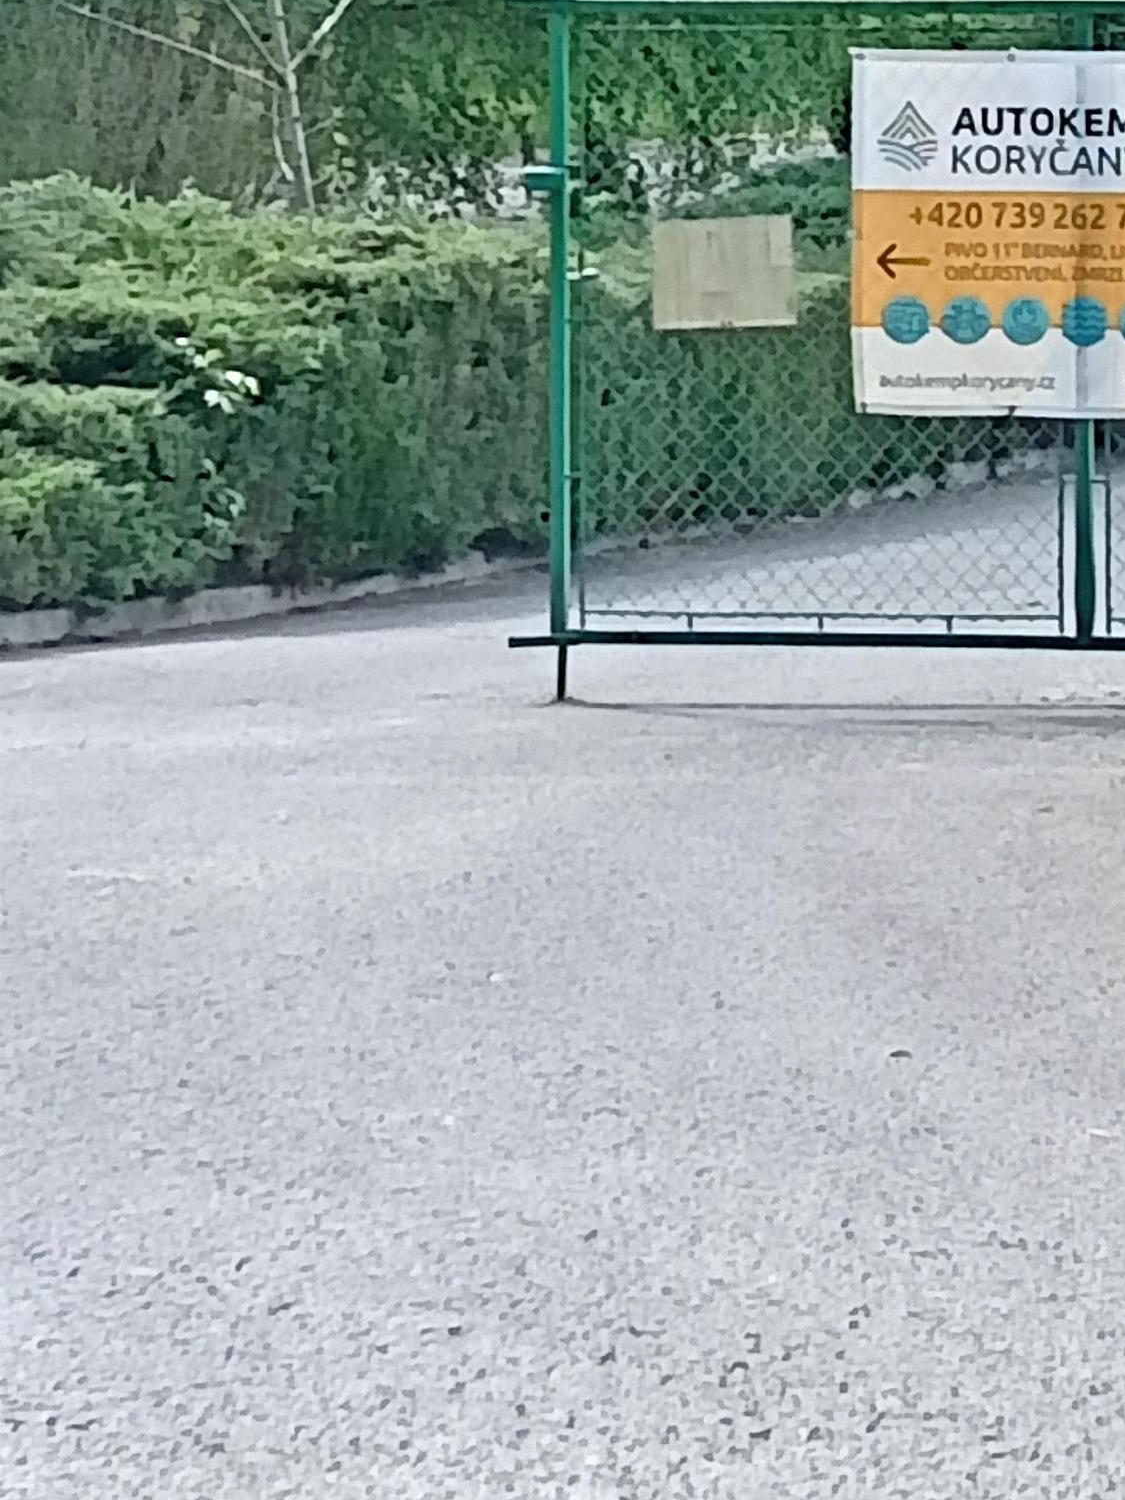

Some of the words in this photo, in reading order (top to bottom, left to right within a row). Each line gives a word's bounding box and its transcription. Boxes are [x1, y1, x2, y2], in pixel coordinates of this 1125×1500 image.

[909, 201, 983, 229] +420
[991, 202, 1046, 229] 739
[1053, 202, 1107, 230] 262
[944, 242, 988, 258] PIVO
